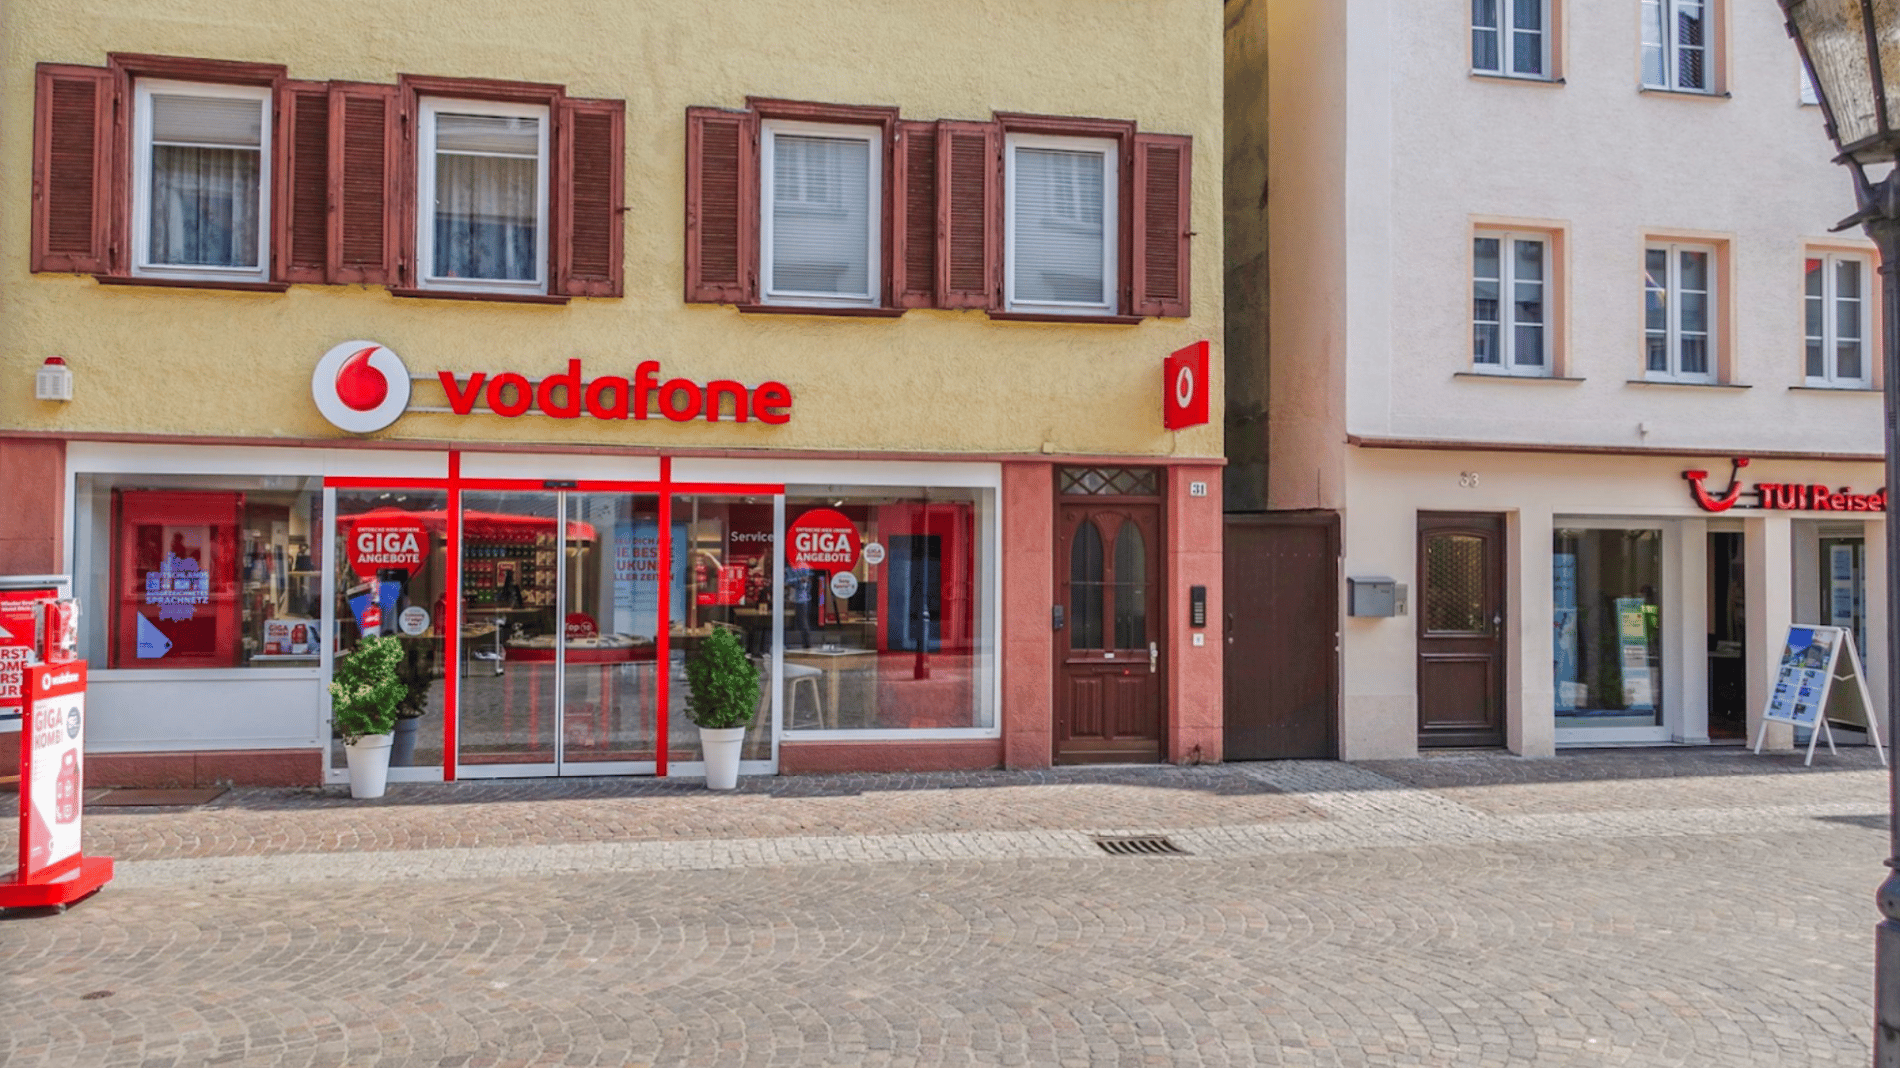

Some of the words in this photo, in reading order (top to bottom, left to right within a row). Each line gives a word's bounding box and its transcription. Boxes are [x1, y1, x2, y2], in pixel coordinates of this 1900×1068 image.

[438, 358, 792, 424] vodafone
[1459, 471, 1479, 488] 33
[1192, 484, 1205, 495] 31
[1756, 483, 1807, 510] TUI
[357, 532, 420, 553] GIGA
[795, 533, 852, 552] GIGA
[357, 553, 420, 563] ANGEBOTE
[633, 547, 674, 558] BESE
[795, 552, 852, 563] ANGEBOTE
[614, 573, 638, 581] LLER
[1, 649, 29, 660] RST
[34, 706, 63, 733] GIGA
